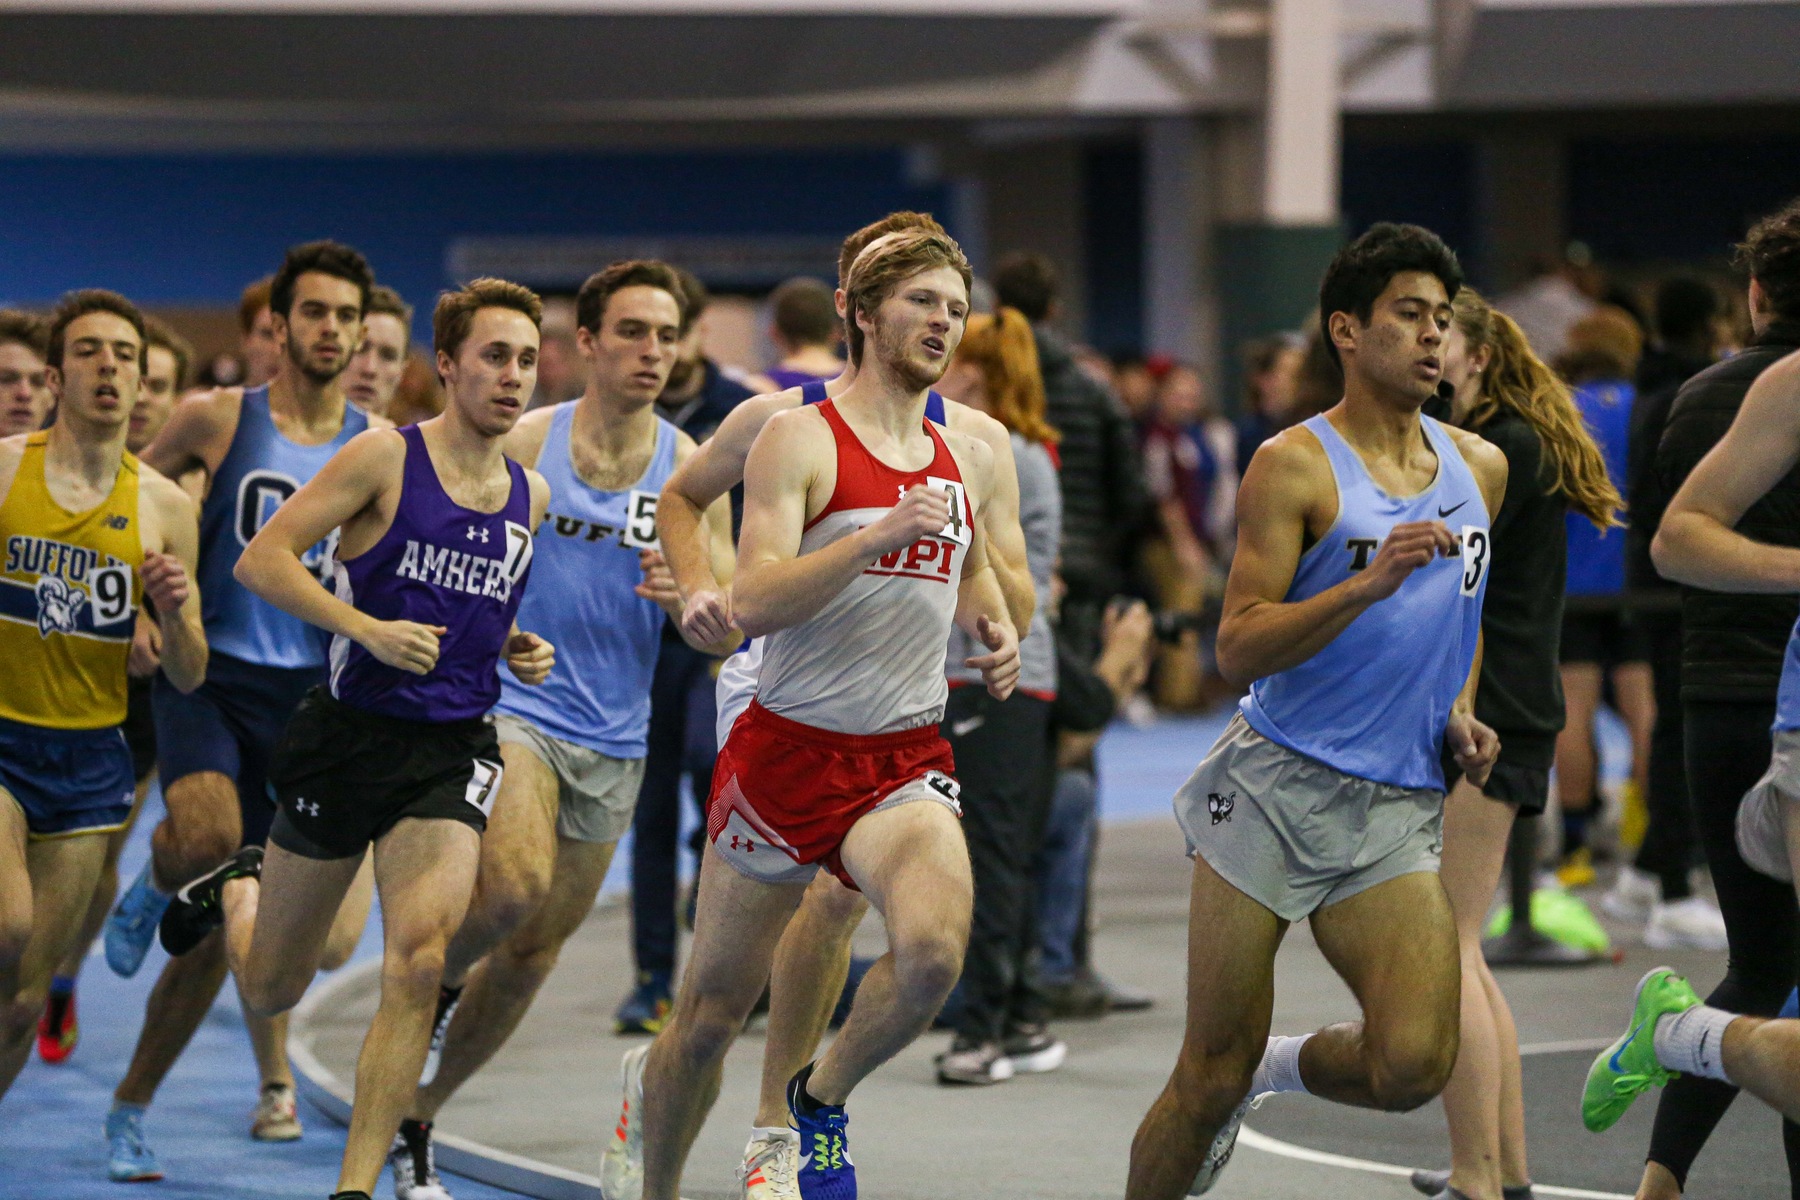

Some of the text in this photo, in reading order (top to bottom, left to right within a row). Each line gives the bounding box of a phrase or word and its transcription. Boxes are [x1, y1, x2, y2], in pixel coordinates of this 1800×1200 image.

[632, 495, 658, 543] 5
[5, 535, 124, 585] SUFFO
[508, 527, 529, 578] 7
[1464, 531, 1487, 591] 3
[96, 570, 127, 619] 9
[475, 759, 498, 807] 7
